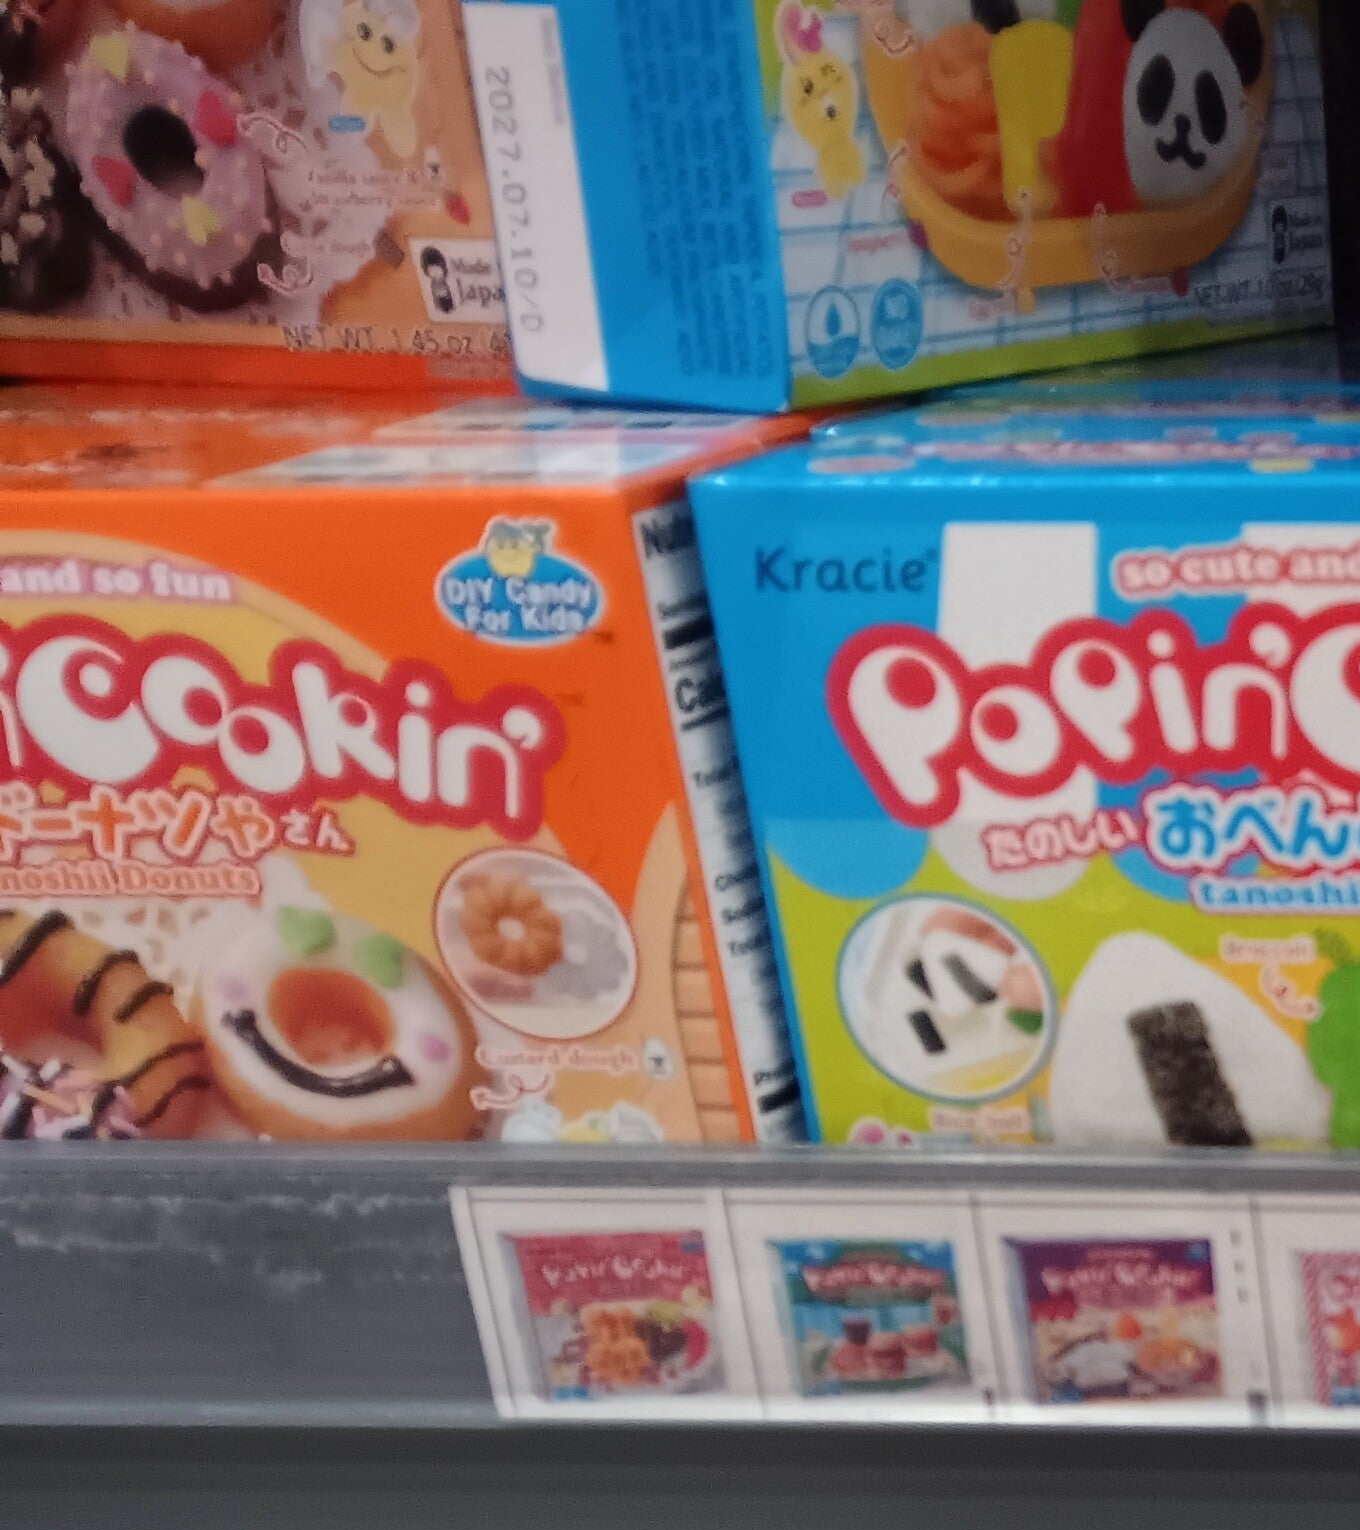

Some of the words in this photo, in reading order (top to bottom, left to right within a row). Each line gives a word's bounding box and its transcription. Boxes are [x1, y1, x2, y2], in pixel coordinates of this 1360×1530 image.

[101, 568, 146, 598] so
[150, 561, 233, 601] fun
[754, 547, 927, 594] Kracie
[1118, 552, 1174, 594] so
[1179, 547, 1279, 586] cute
[444, 574, 497, 606] DIY
[501, 575, 594, 613] Candy
[465, 604, 519, 632] For
[523, 605, 589, 634] Kids
[982, 810, 1139, 870] たのしい
[124, 864, 258, 896] Donuts
